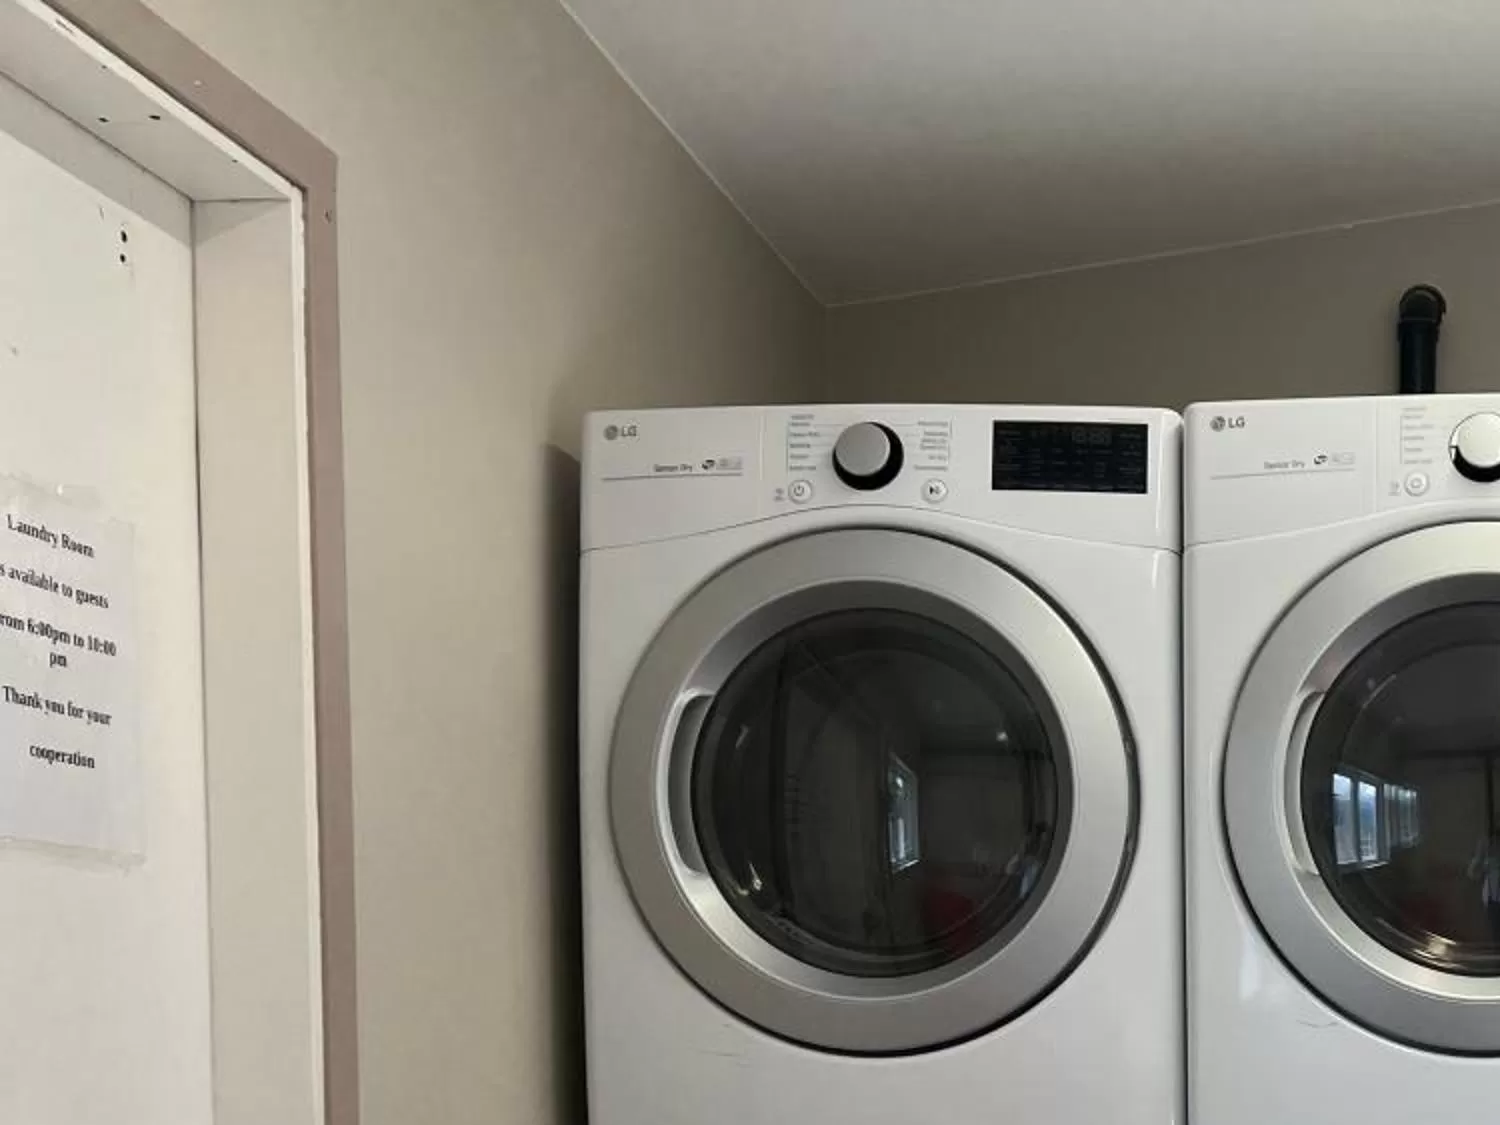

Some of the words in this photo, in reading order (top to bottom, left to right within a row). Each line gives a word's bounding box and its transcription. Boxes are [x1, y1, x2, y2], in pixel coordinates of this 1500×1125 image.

[620, 425, 638, 438] LG
[1228, 415, 1247, 429] LG
[7, 513, 58, 549] Laundry
[61, 533, 95, 558] Room
[8, 567, 59, 594] available
[61, 583, 73, 599] to
[75, 588, 109, 609] guests
[0, 613, 25, 631] rom
[27, 618, 71, 645] 6:00pm
[73, 633, 85, 648] to
[86, 635, 117, 657] 10:00
[49, 651, 67, 669] pm
[2, 685, 43, 710] Thank
[44, 698, 65, 715] you
[67, 700, 86, 719] for
[86, 708, 112, 726] your
[29, 744, 96, 769] cooperation
